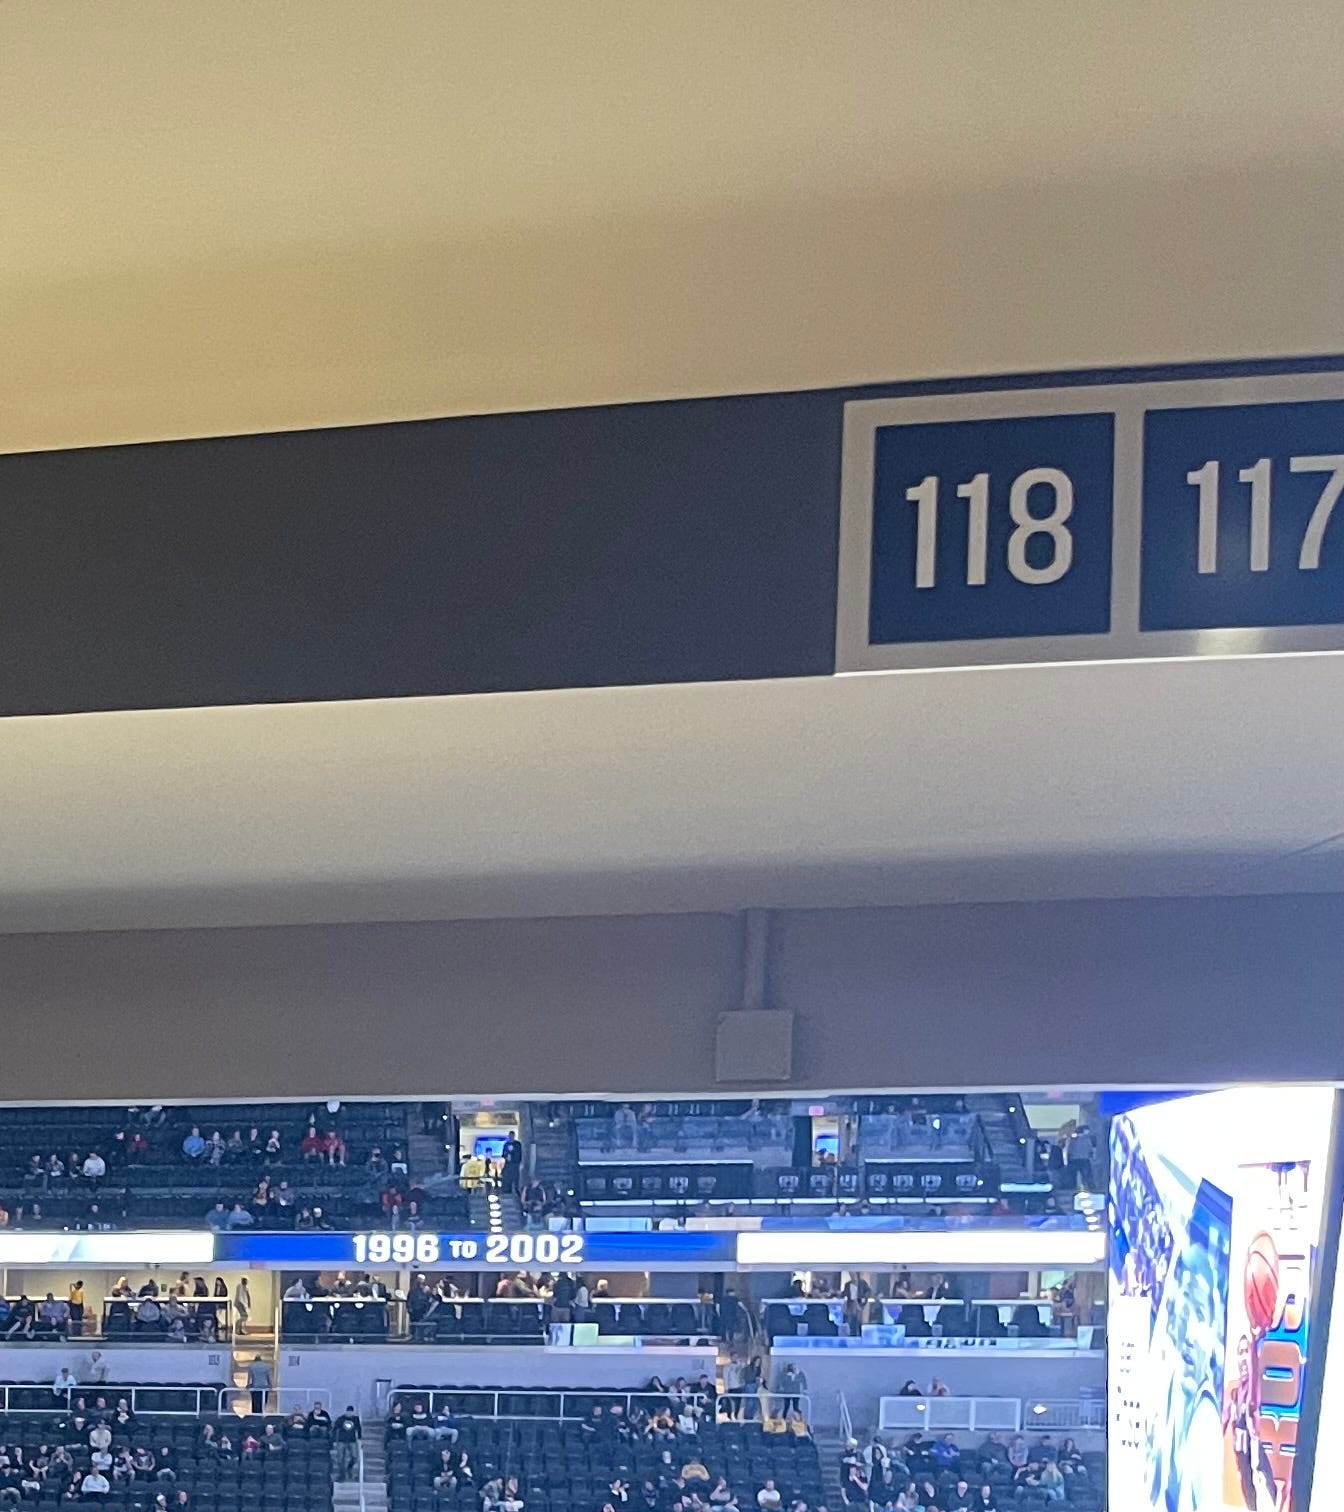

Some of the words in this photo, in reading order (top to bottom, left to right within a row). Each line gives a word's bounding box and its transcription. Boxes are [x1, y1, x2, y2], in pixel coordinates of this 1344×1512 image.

[905, 467, 1074, 588] 118
[1186, 455, 1344, 574] 117
[353, 1234, 439, 1263] 1996
[449, 1241, 476, 1259] TO
[485, 1233, 584, 1263] 2002
